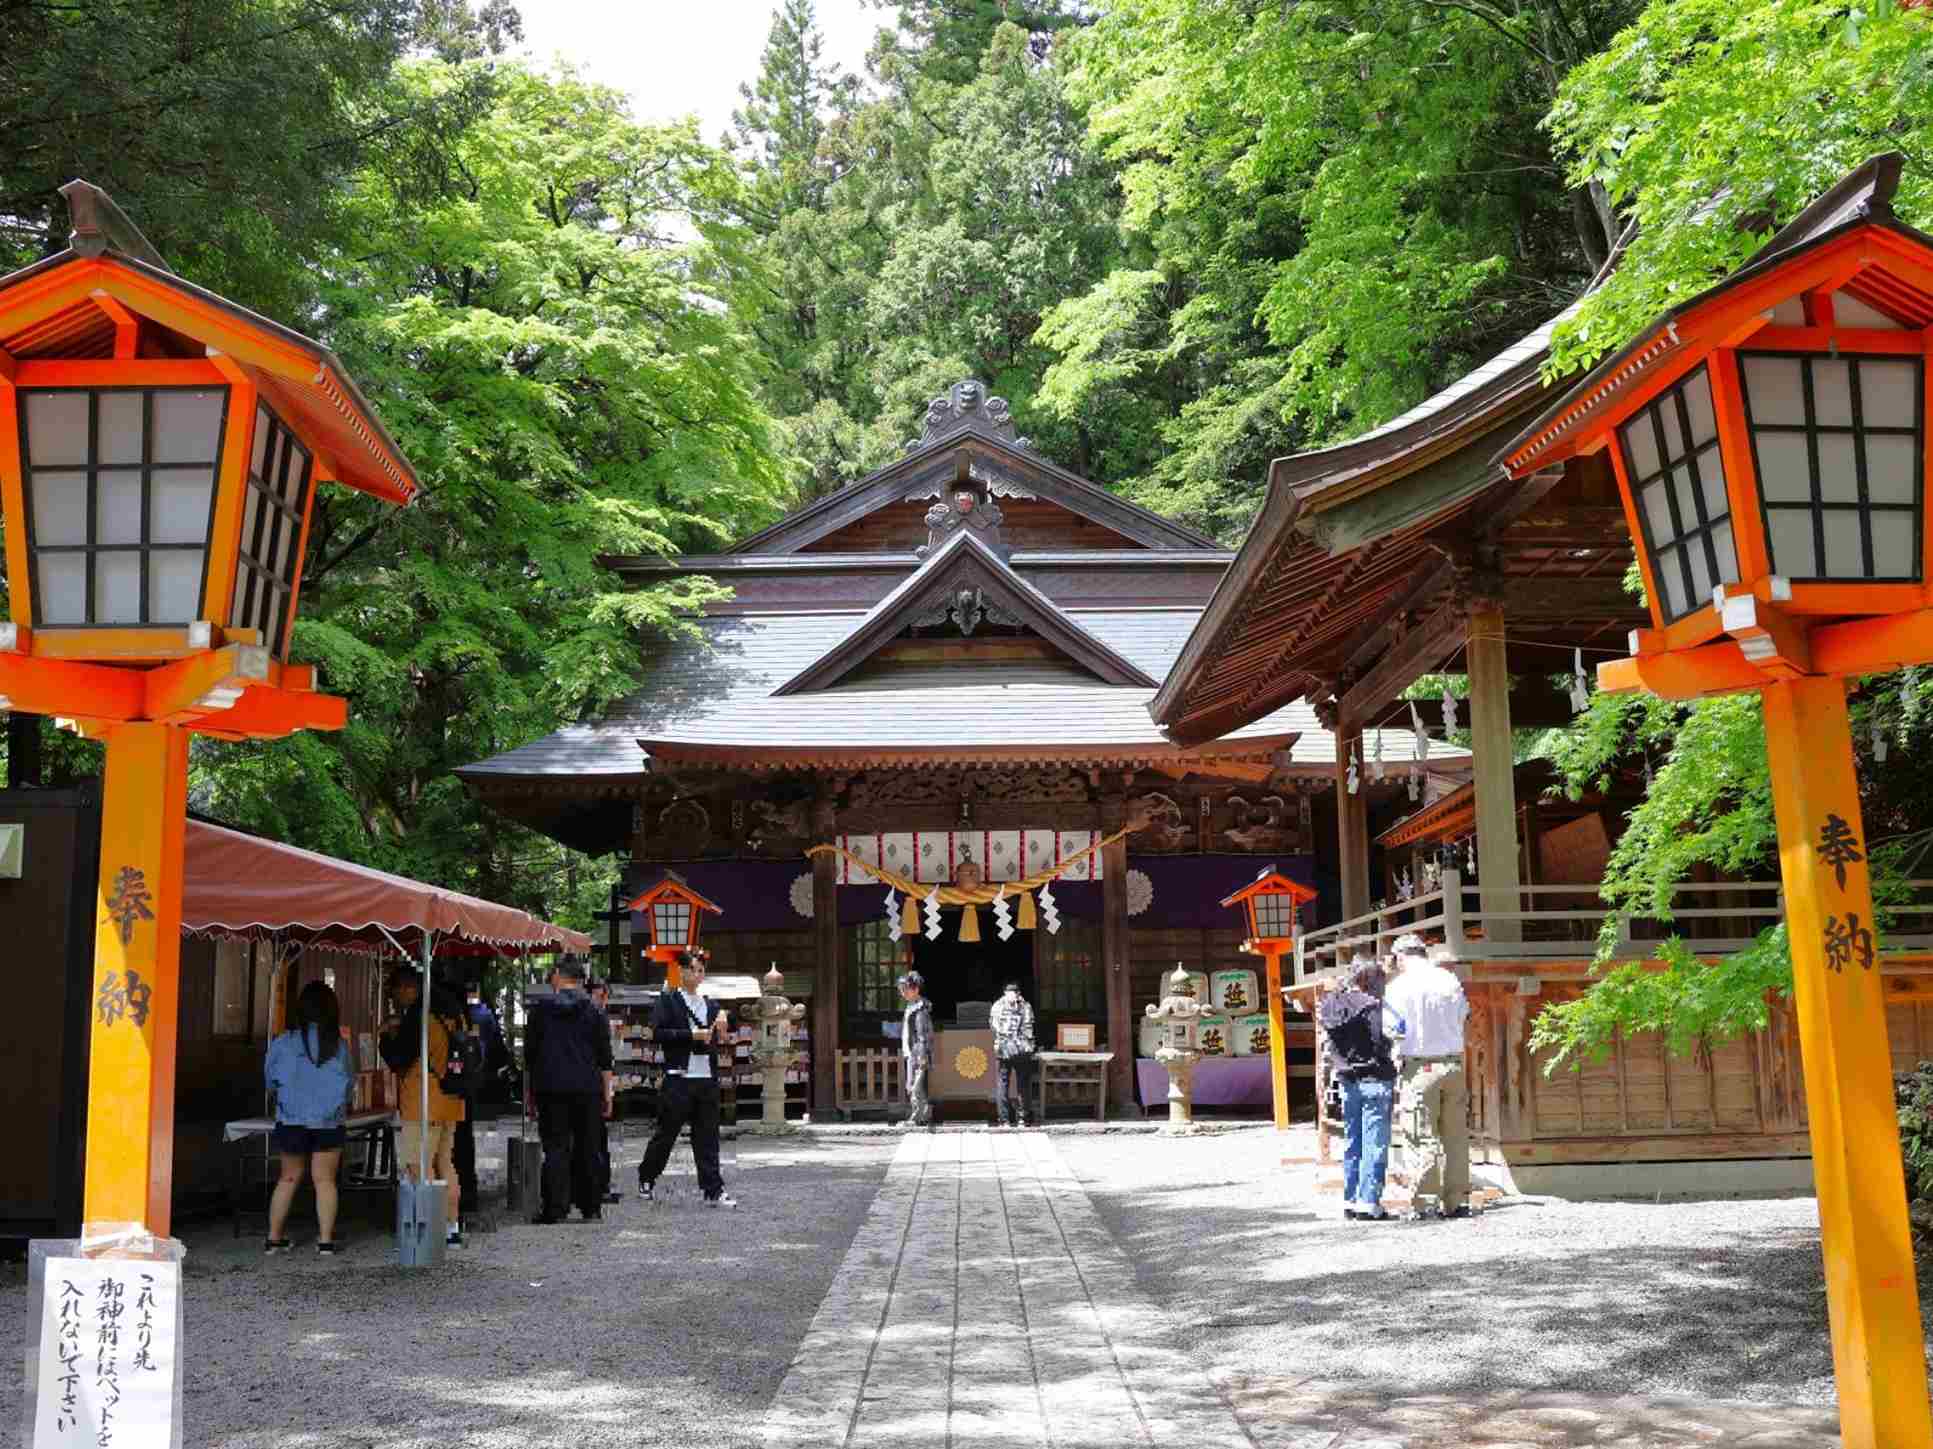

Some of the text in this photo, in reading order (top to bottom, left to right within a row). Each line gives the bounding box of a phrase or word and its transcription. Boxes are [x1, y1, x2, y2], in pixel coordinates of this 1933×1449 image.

[97, 865, 154, 1028] 奉納
[1816, 814, 1874, 973] 奉納
[95, 1277, 125, 1447] 御神前にはペットを
[133, 1273, 157, 1372] これより先
